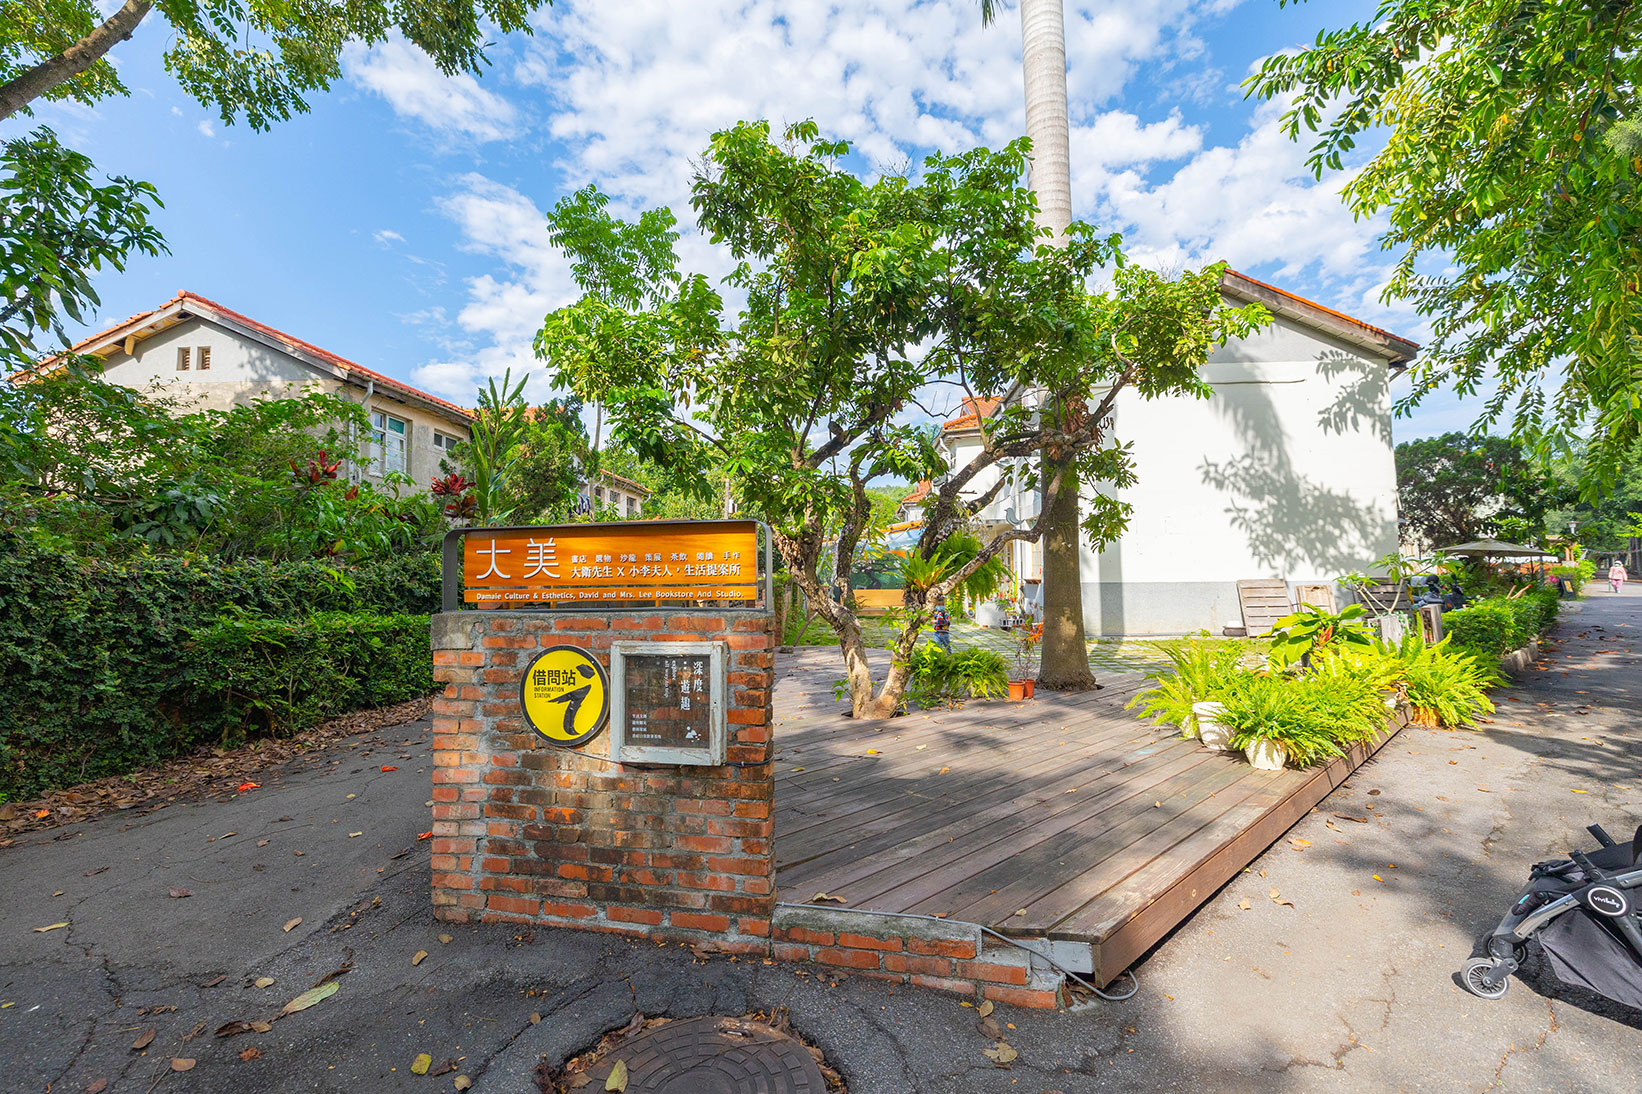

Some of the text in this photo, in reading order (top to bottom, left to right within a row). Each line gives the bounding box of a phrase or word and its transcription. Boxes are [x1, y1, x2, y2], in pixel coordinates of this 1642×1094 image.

[476, 537, 560, 579] 大美
[571, 565, 613, 578] 大衛先生
[504, 591, 530, 600] Culture
[541, 591, 576, 600] Esthetics,
[579, 590, 599, 599] David
[602, 591, 616, 599] and
[620, 590, 635, 599] Mrs.
[639, 590, 652, 598] Lee
[655, 590, 694, 598] Bookstore
[697, 590, 712, 598] And
[716, 589, 744, 598] Studio.
[532, 669, 576, 686] 借問站
